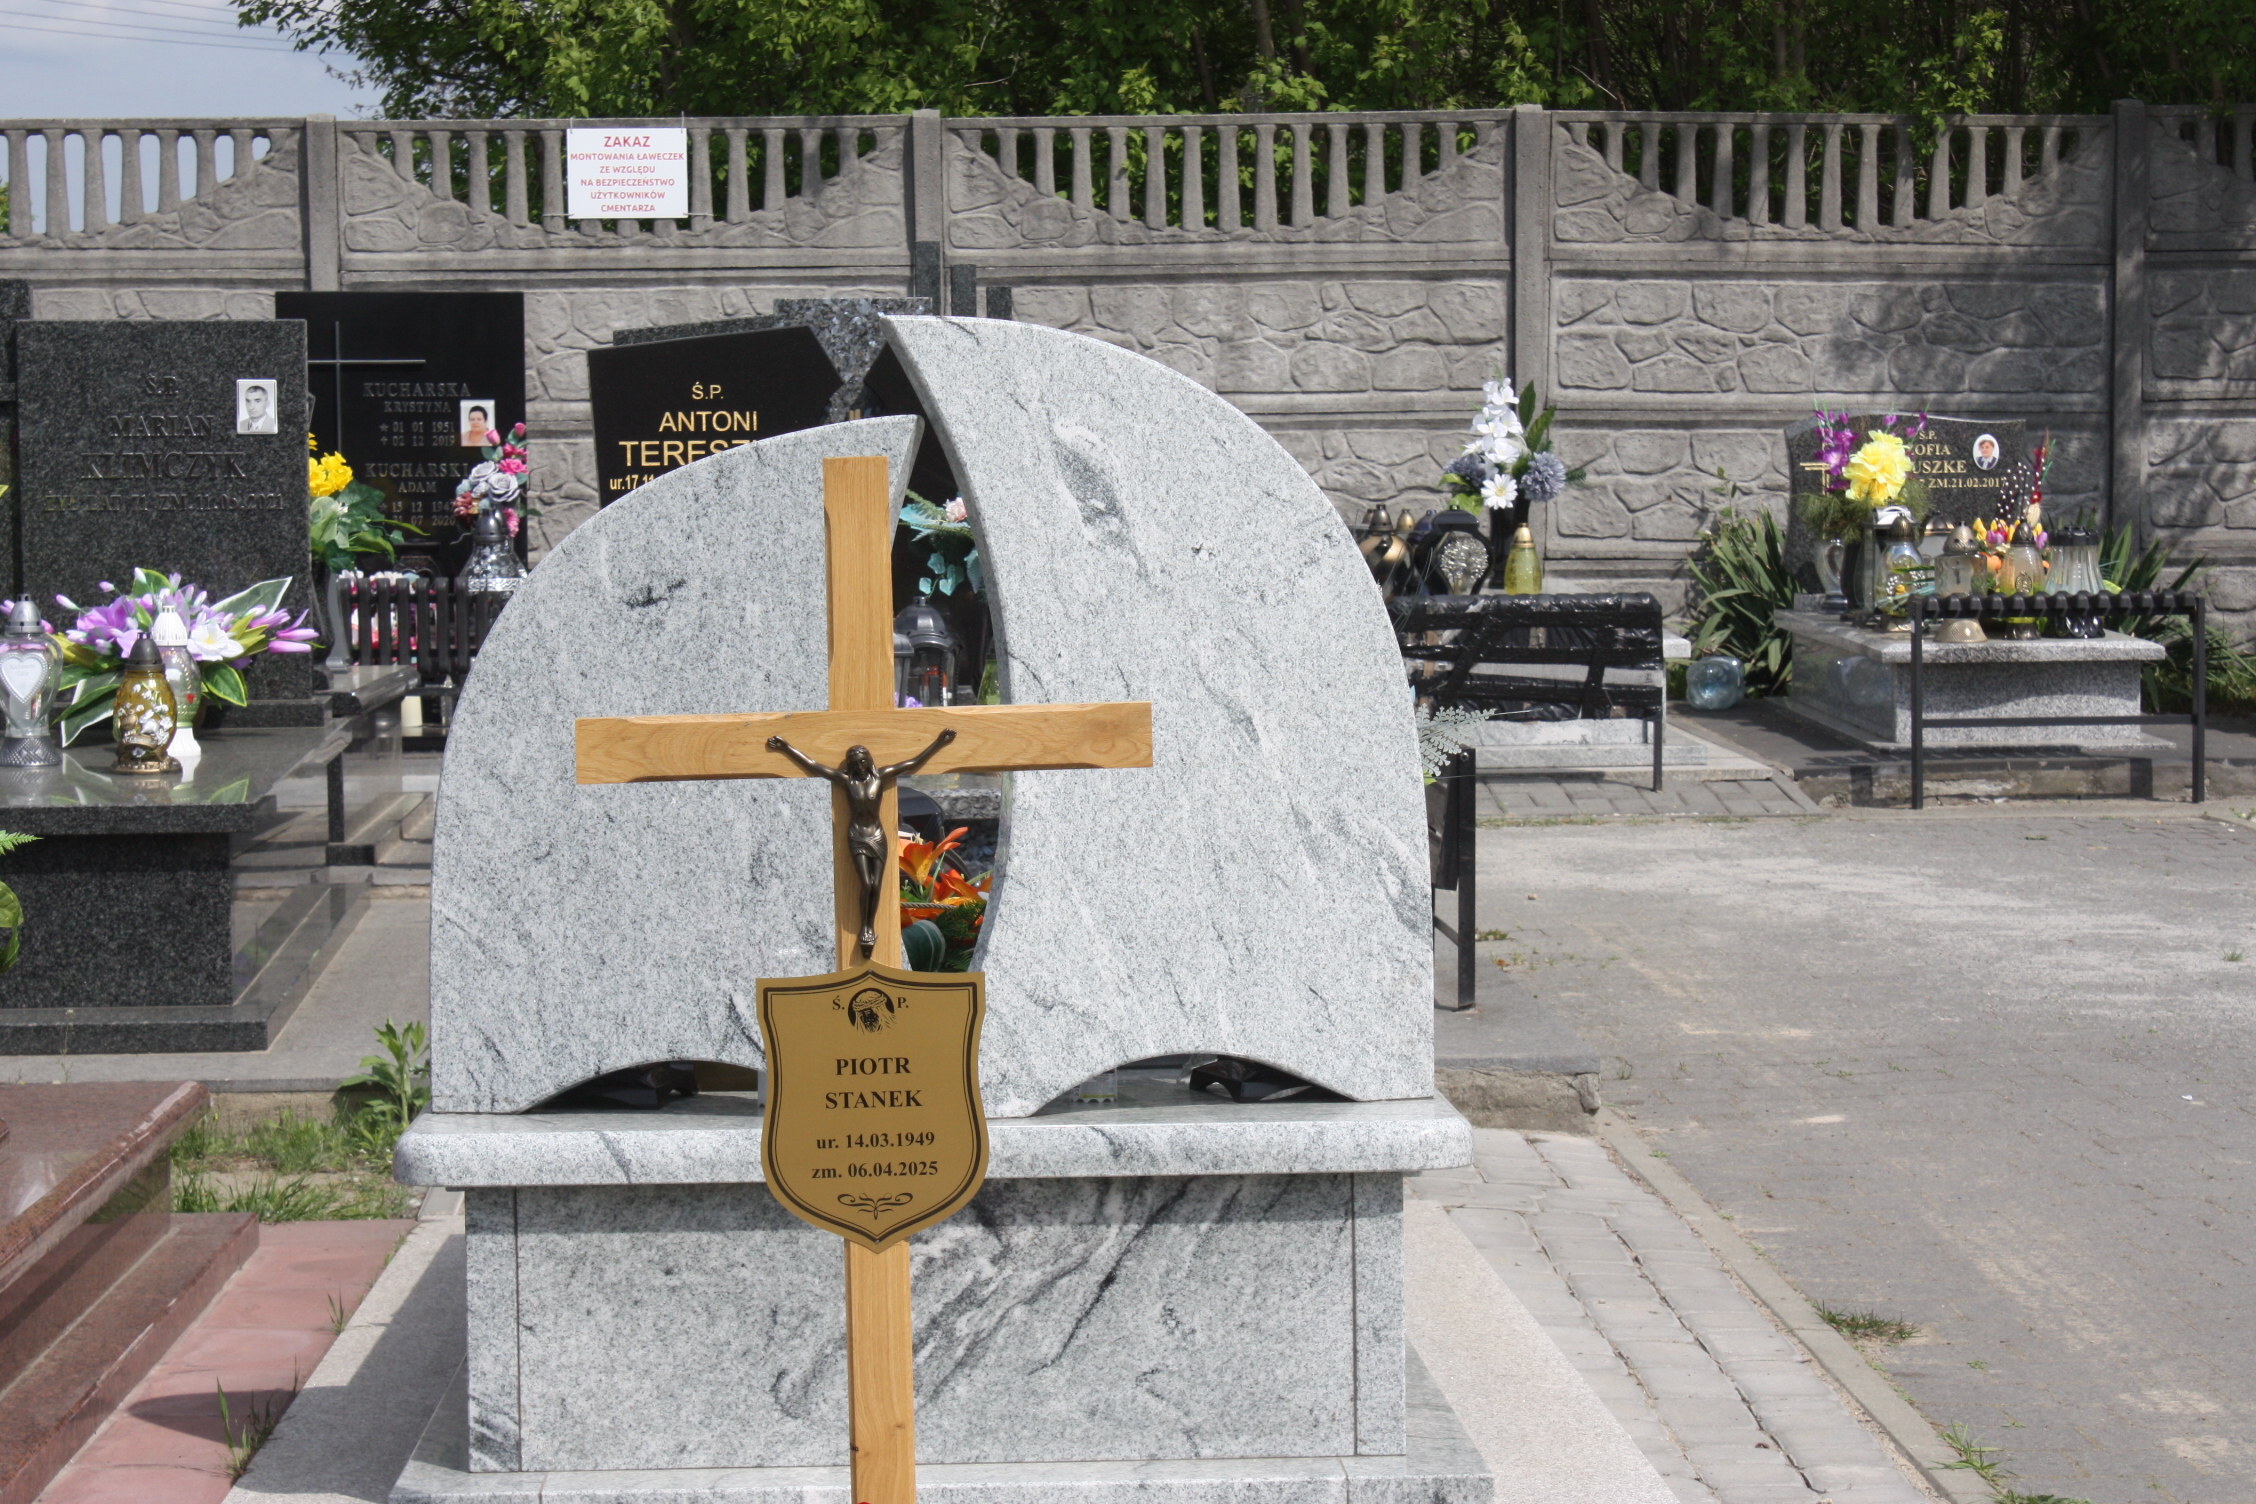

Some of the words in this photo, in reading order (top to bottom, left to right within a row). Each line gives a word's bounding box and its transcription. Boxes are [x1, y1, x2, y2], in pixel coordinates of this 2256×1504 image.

[604, 136, 651, 147] ZAKAZ
[613, 166, 656, 175] WZGLĘDU
[596, 177, 675, 186] BEZPIECZEŃSTWO
[590, 190, 665, 199] UŻYTKOWNIKÓW
[362, 383, 471, 397] KUCHARSKA
[692, 381, 724, 400] Ś.P.
[384, 401, 451, 412] KRYSTYNA
[109, 415, 215, 437] MARIAN
[659, 411, 758, 432] ANTONI
[1911, 444, 1951, 456] OFIA
[81, 452, 247, 479] KLIMCZYK
[365, 463, 469, 478] KUCHARSKI
[398, 481, 437, 492] ADAM
[832, 995, 845, 1011] Ś.
[897, 997, 909, 1009] P.
[835, 1057, 911, 1075] PIOTR
[825, 1090, 923, 1109] STANEK
[816, 1136, 839, 1149] ur.
[845, 1131, 935, 1148] 14.03.1949
[812, 1168, 842, 1179] zm.
[848, 1160, 938, 1177] 06.04.2025
